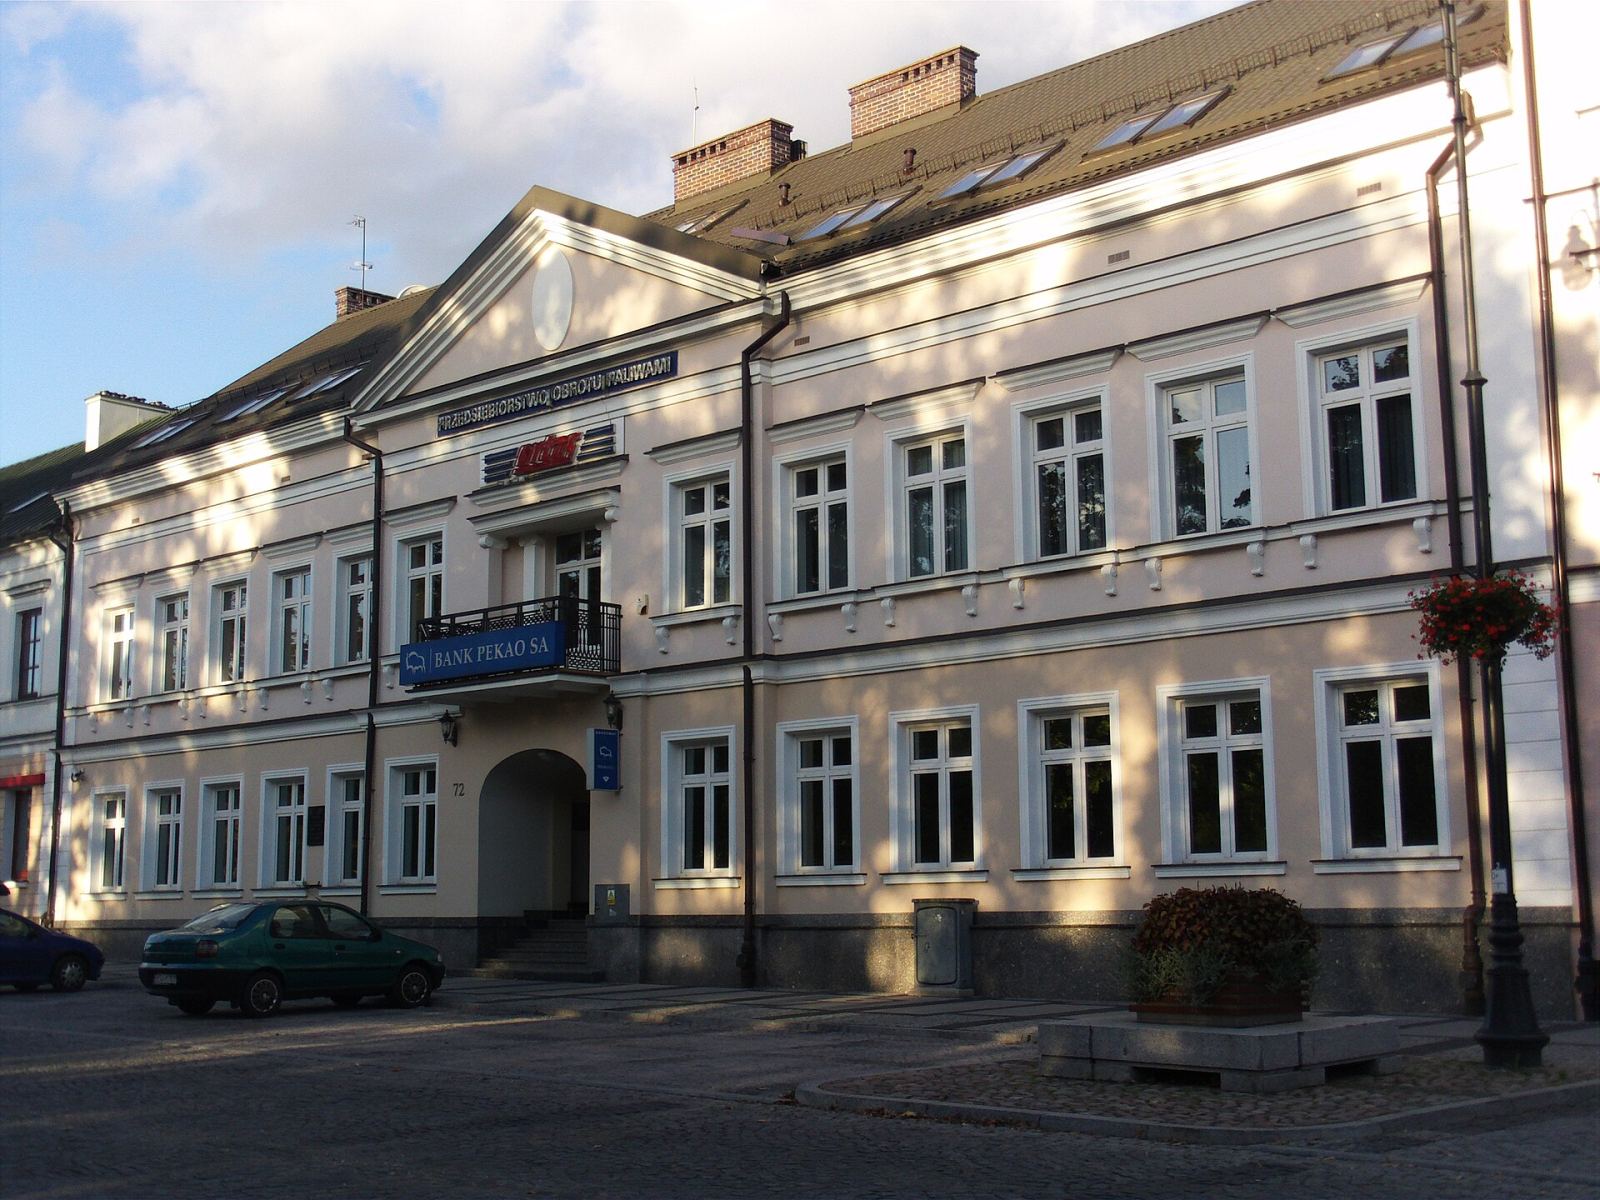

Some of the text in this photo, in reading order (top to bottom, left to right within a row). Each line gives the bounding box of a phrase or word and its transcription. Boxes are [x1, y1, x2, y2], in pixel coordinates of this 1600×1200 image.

[552, 374, 602, 401] OBROTU
[607, 356, 671, 387] PALIWAMI
[435, 636, 549, 668] BANK PEKAO SA
[453, 782, 465, 796] 72
